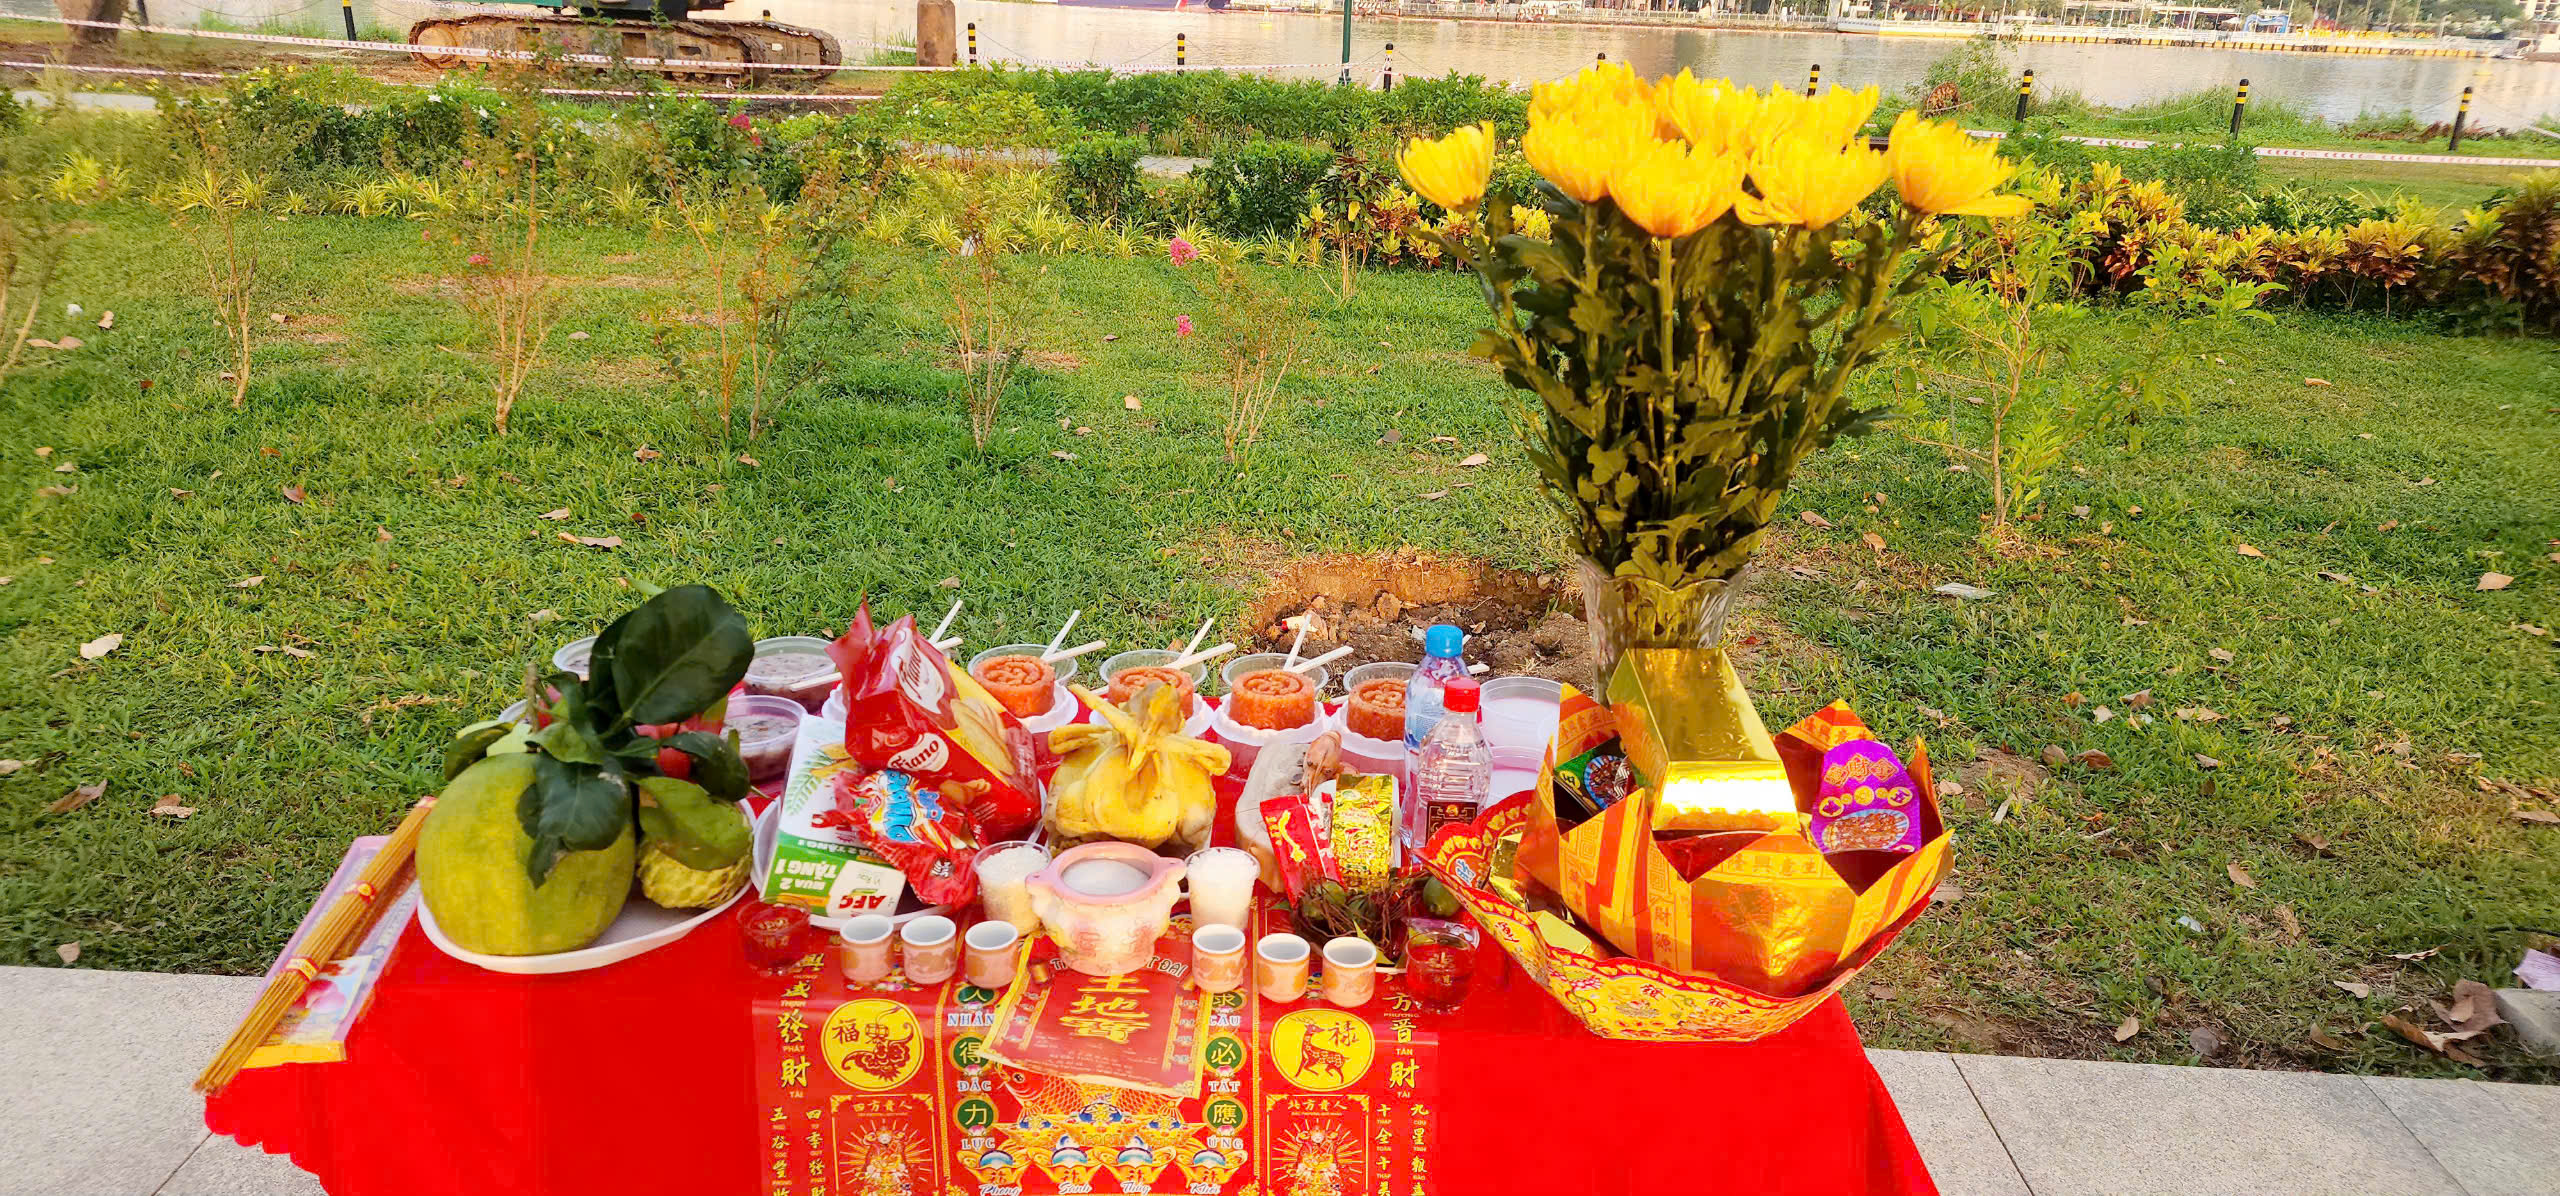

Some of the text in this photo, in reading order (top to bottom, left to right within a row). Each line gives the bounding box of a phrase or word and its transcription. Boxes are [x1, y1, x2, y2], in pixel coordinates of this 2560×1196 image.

[775, 859, 787, 875] 1
[780, 878, 826, 891] MUA 2
[838, 895, 887, 909] AFC
[831, 1018, 860, 1045] 福
[1211, 1041, 1236, 1065] 必
[964, 1103, 987, 1125] 力
[1213, 1103, 1237, 1124] 應
